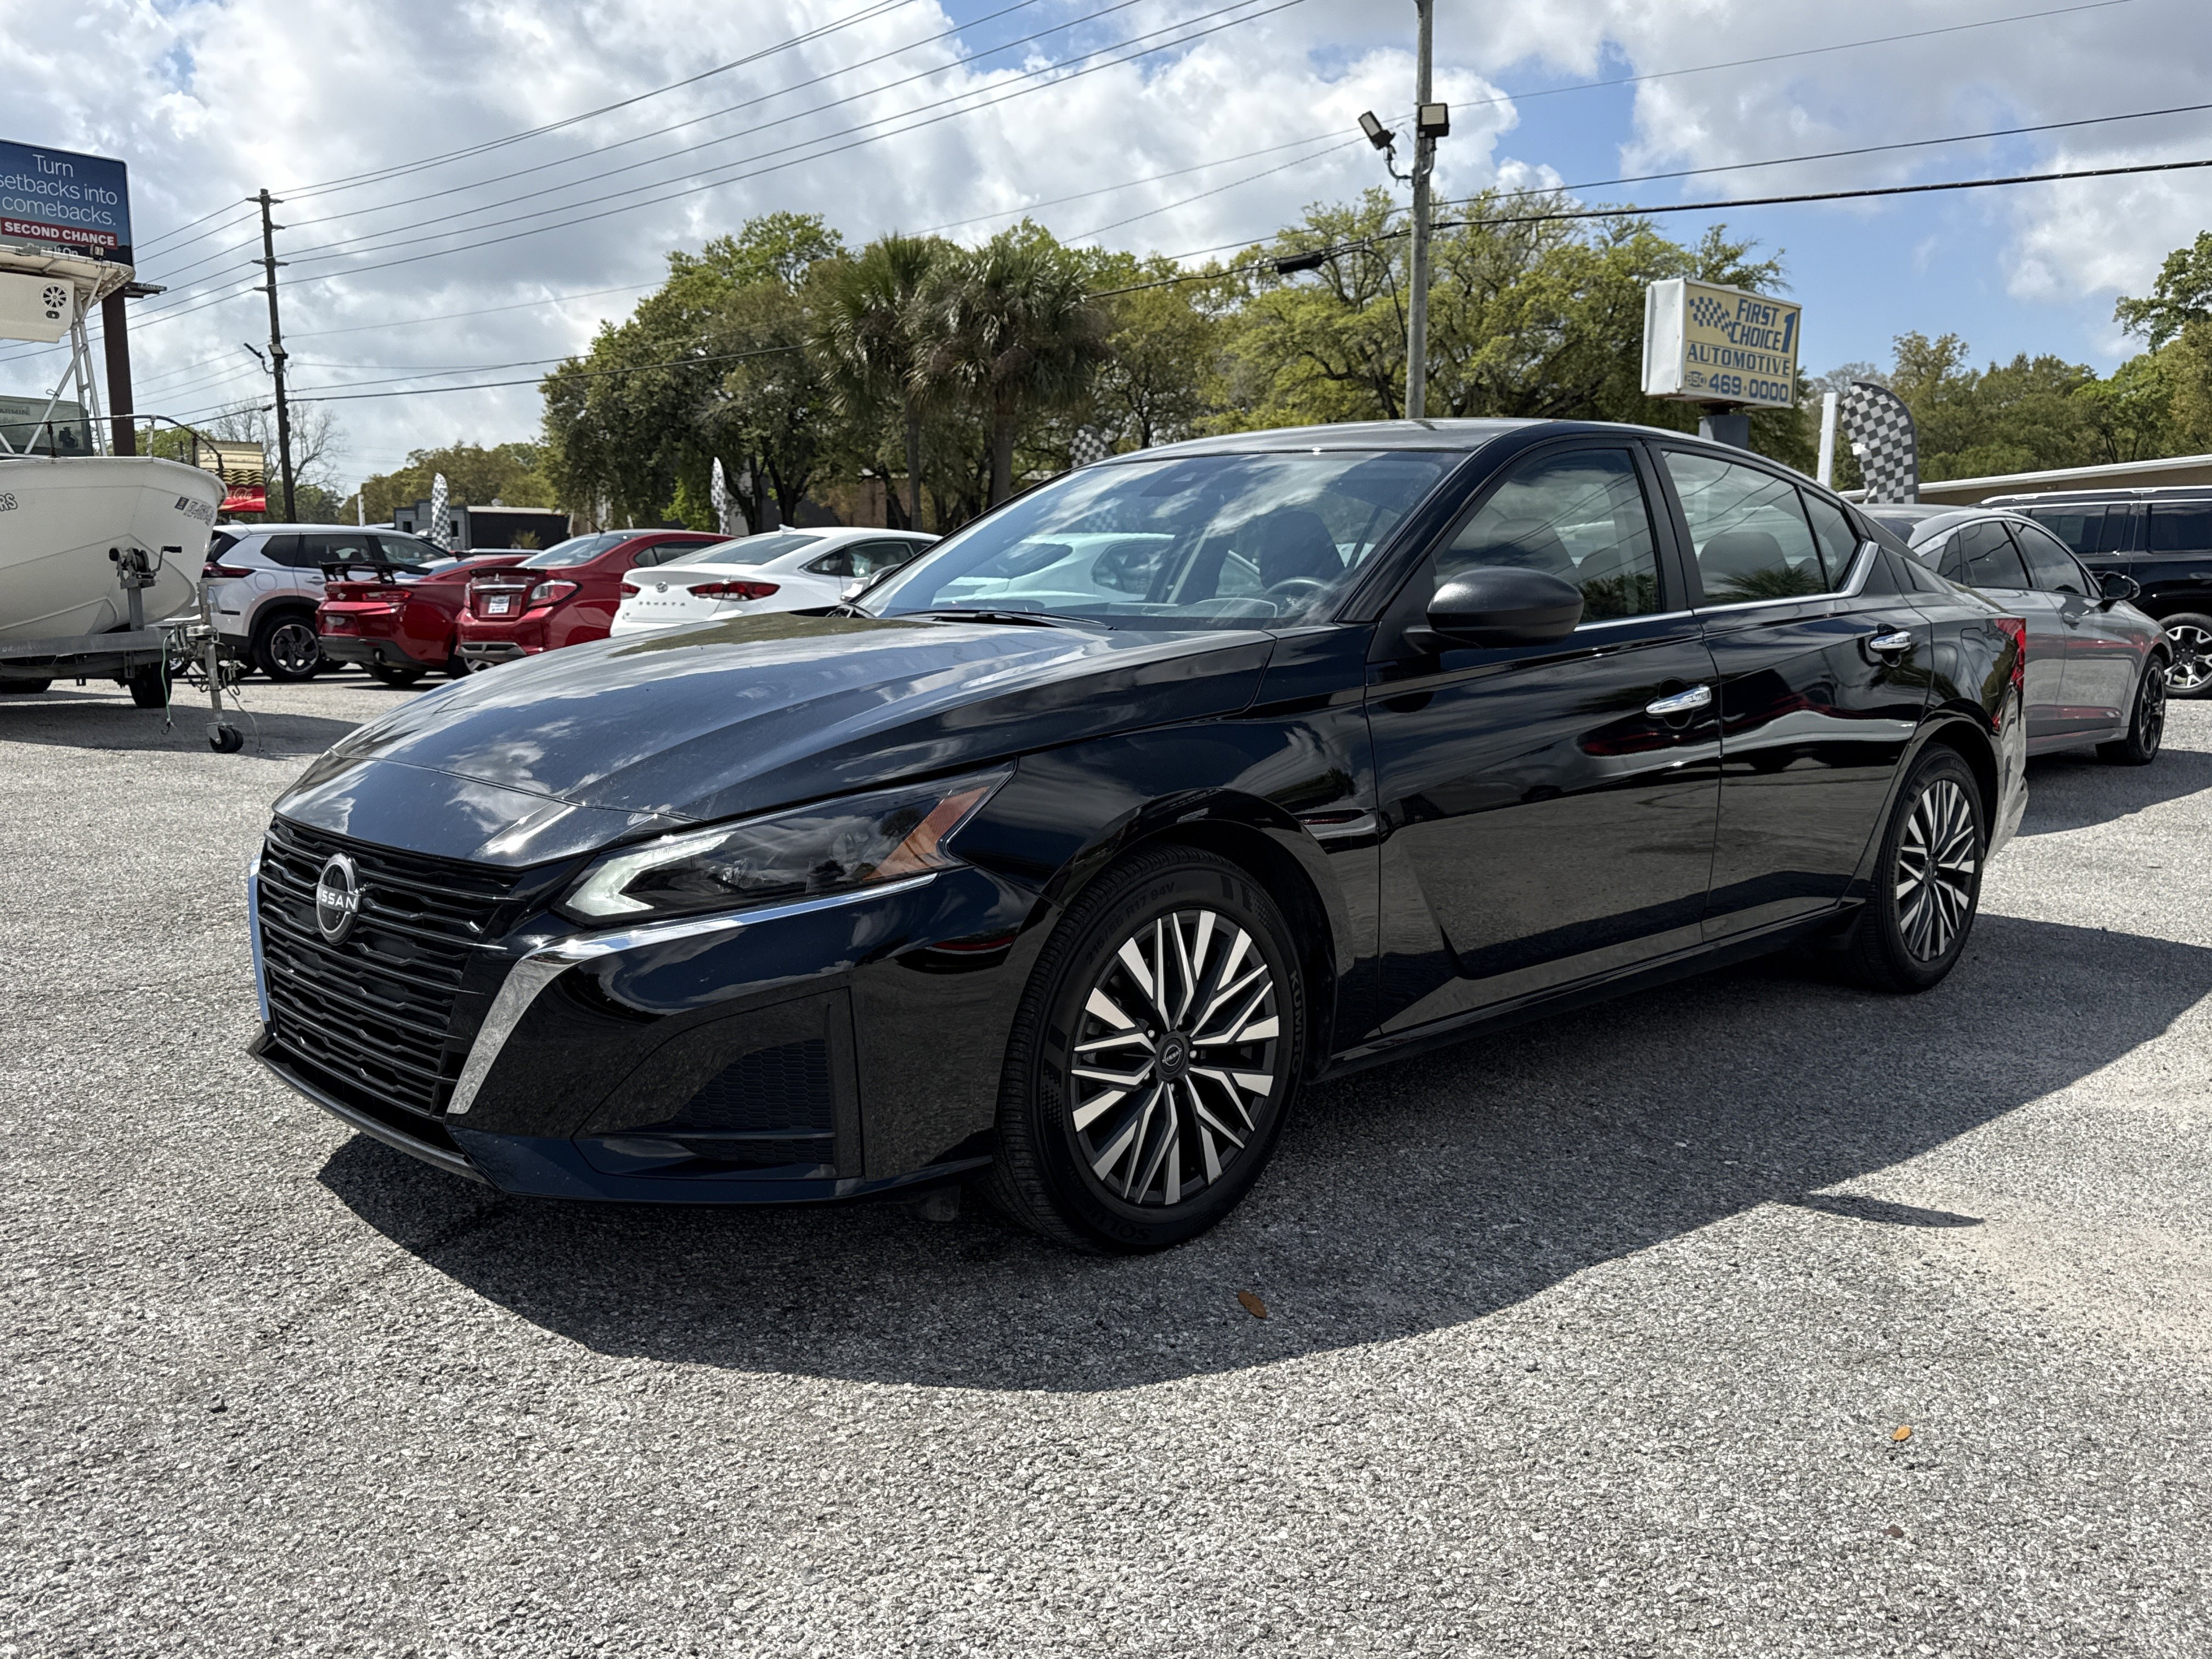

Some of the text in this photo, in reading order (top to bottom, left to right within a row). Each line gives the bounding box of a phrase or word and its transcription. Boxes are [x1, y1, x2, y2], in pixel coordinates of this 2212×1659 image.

[32, 154, 74, 177] Turn
[84, 183, 117, 205] into
[2, 196, 116, 226] comebacks.
[4, 221, 115, 246] SECOND CHANCE
[1736, 298, 1780, 327] FIRST
[1730, 312, 1796, 353] CHOICE 1
[1687, 343, 1790, 376] AUTOMOTIVE
[1125, 895, 1147, 918] R17
[1290, 970, 1303, 1074] KUMHO
